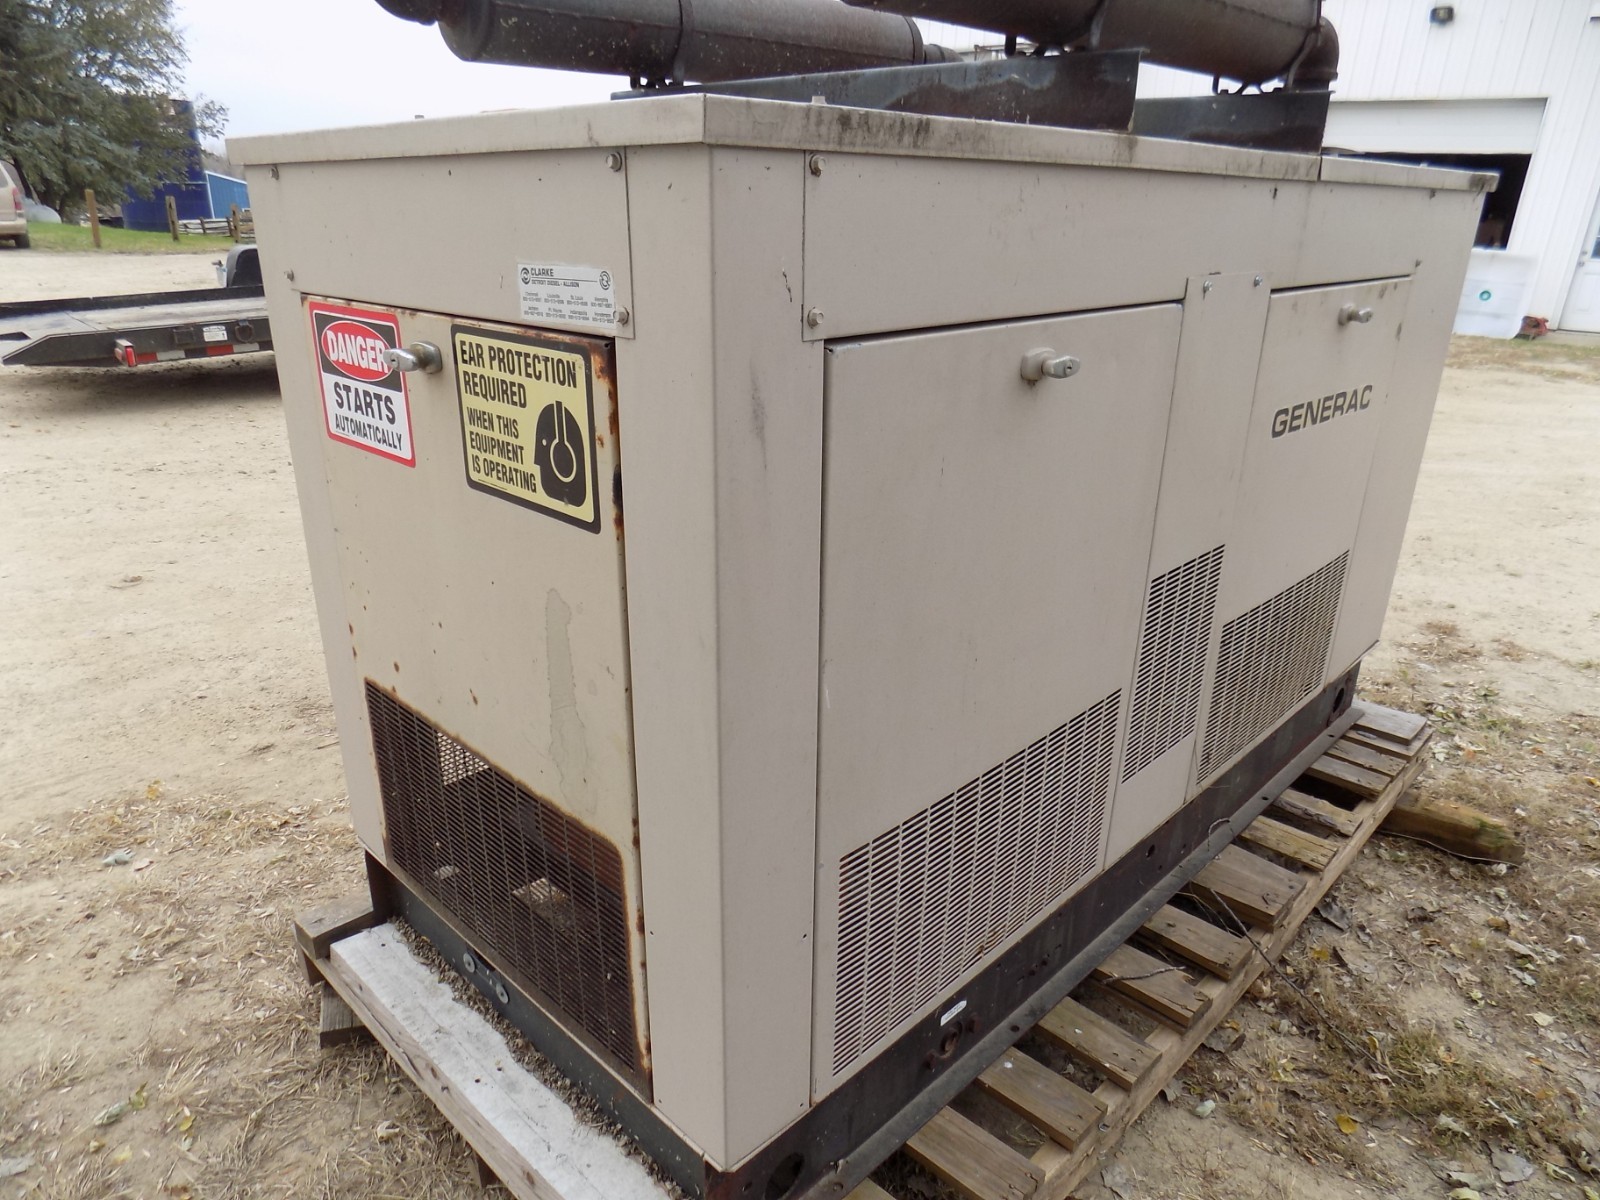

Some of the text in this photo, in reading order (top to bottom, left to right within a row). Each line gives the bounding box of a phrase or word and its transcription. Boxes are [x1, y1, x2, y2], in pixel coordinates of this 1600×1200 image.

[530, 267, 554, 277] CLARKE
[326, 329, 389, 374] DANGER
[460, 340, 577, 389] EAR PROTECTION
[333, 381, 396, 425] STARTS
[463, 370, 527, 409] REQUIRED
[467, 407, 519, 440] WHEN THIS
[1271, 385, 1373, 439] GENERAC
[335, 413, 402, 451] AUTOMATICALLY
[469, 430, 524, 465] EQUIPMENT
[472, 454, 481, 474] IS
[483, 458, 537, 493] OPERATING
